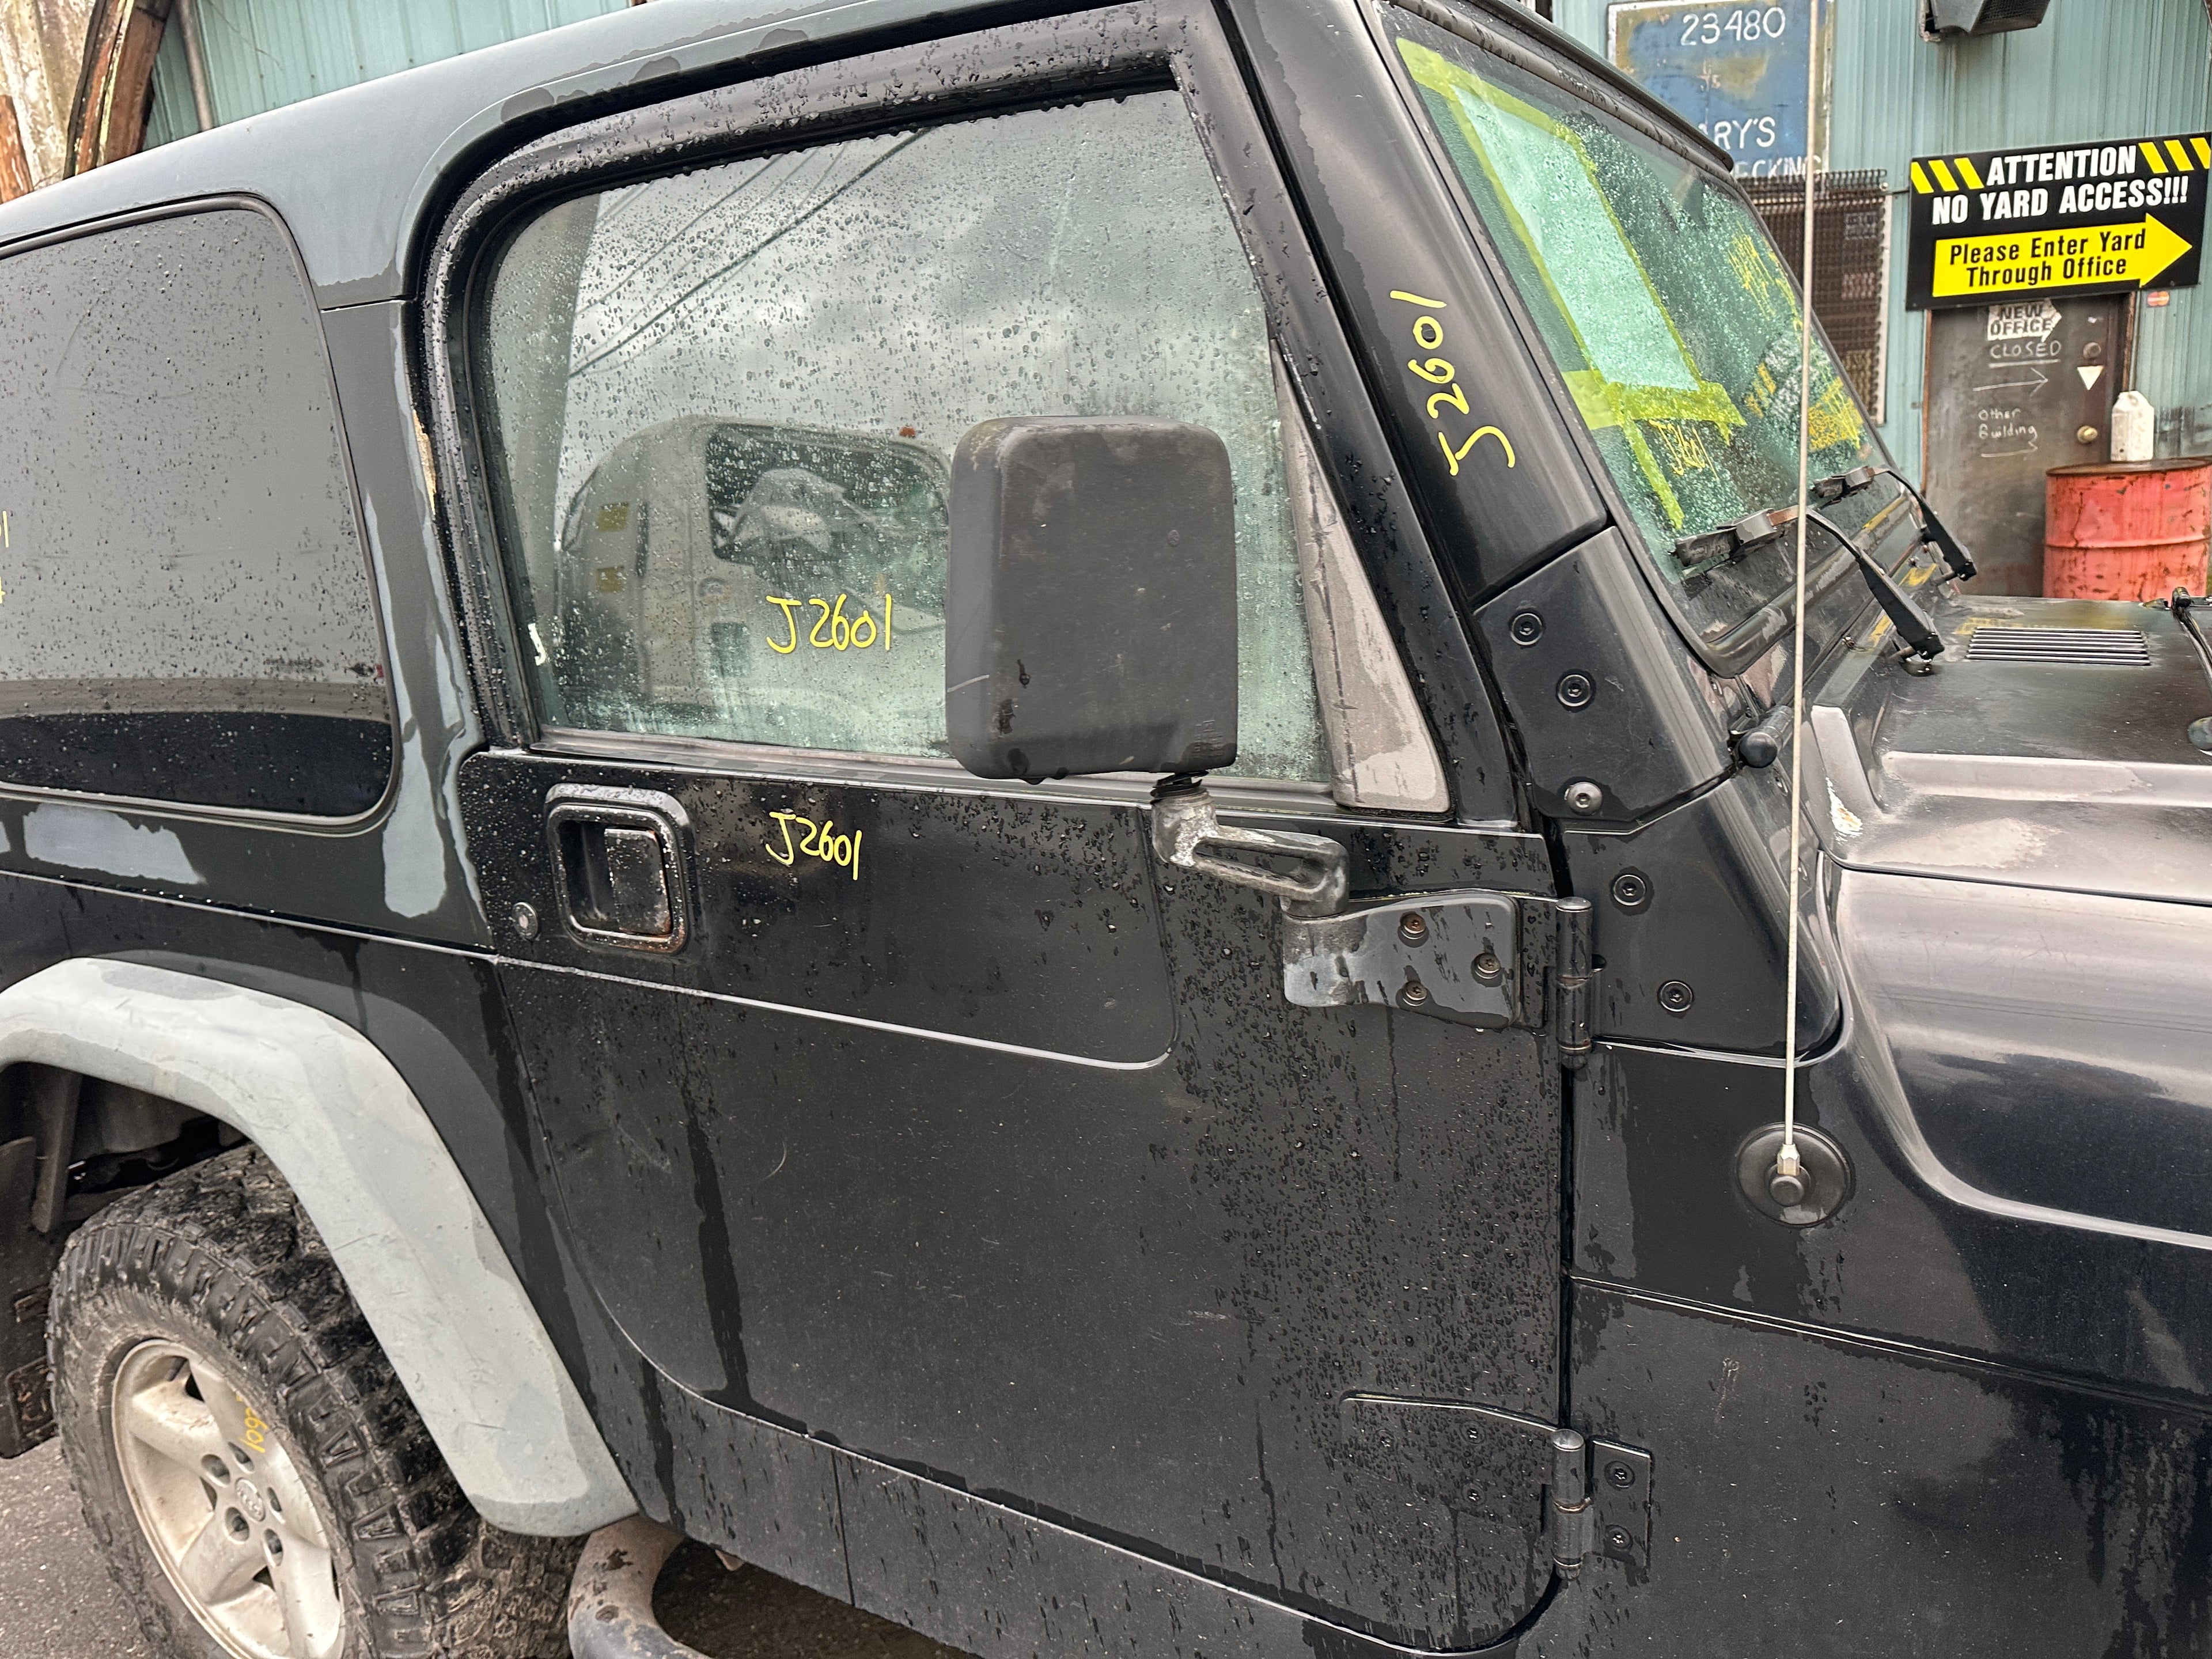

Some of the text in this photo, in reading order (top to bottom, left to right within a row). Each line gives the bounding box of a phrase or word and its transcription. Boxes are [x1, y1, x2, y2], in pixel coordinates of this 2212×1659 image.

[1680, 7, 1786, 46] 23480
[1986, 145, 2137, 186] ATTENTION
[1932, 176, 2189, 225] NO YARD ACCESS!!!
[1950, 228, 2146, 265] Please Enter Yard
[1966, 256, 2127, 286] Through Office
[1999, 304, 2044, 320] NEW
[1990, 340, 2062, 359] CLOSED
[1389, 290, 1516, 476] J2601
[1978, 408, 2021, 421] Other
[766, 593, 892, 654] J2601
[765, 811, 862, 881] J2601
